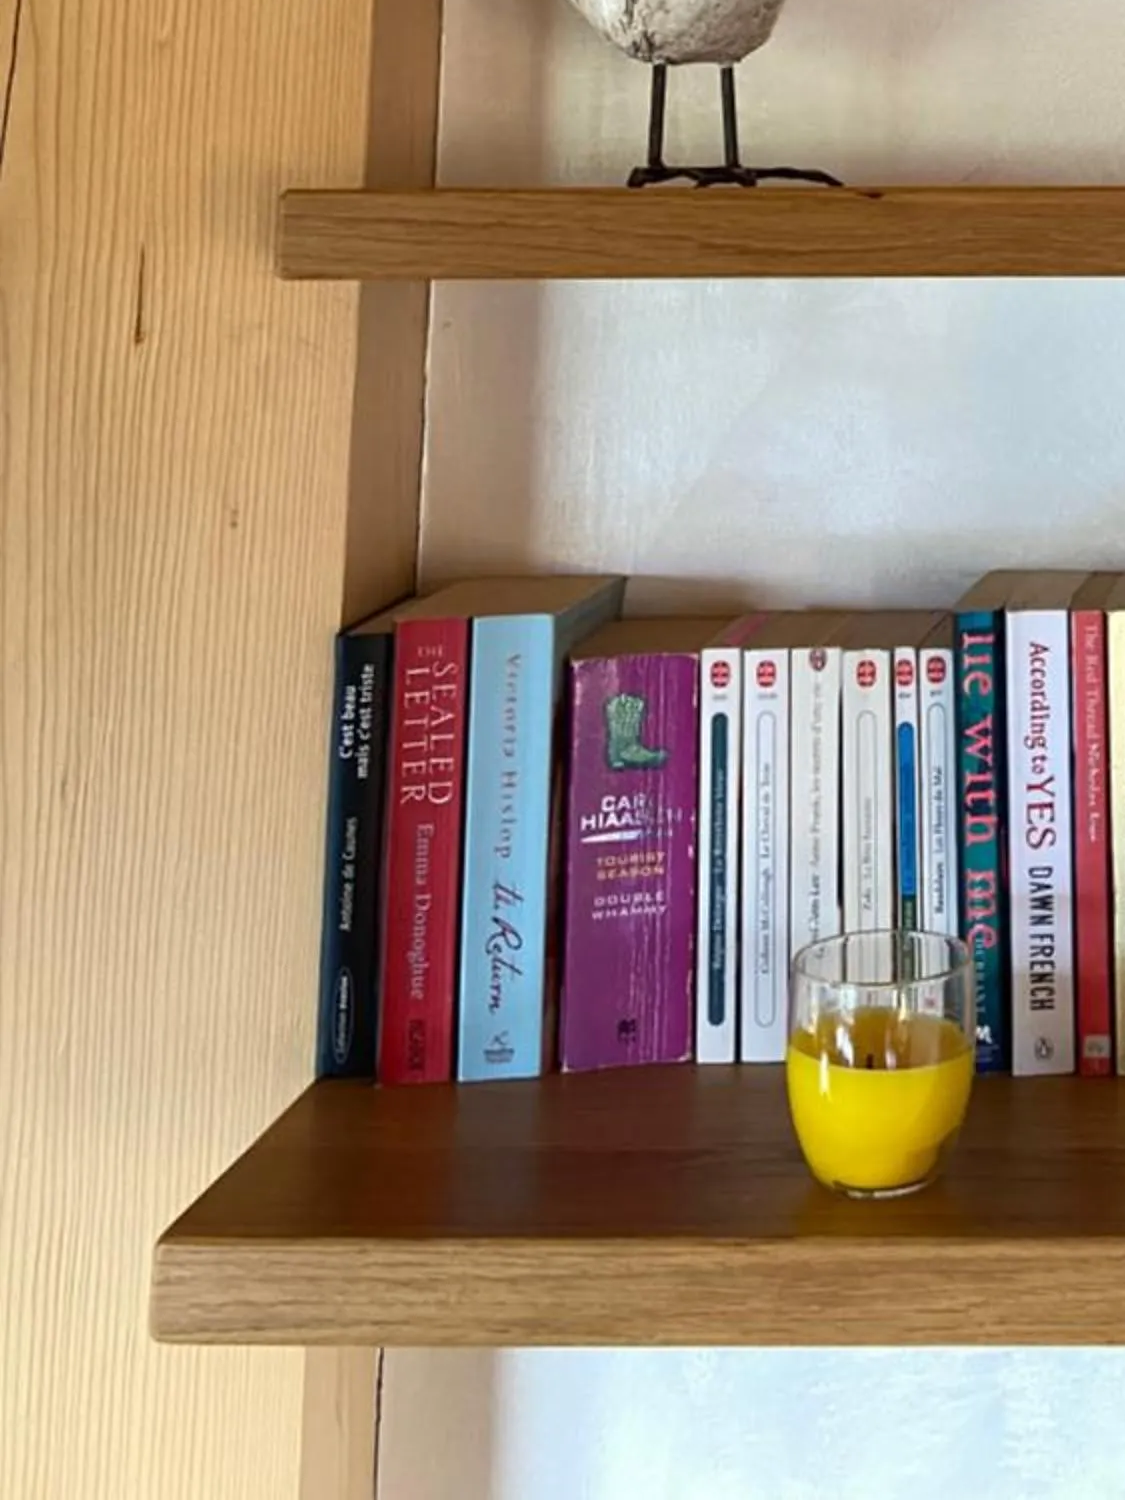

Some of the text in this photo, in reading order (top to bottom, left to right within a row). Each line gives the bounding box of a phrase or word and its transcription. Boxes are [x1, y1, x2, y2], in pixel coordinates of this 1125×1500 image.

[339, 684, 357, 759] C'est beau
[355, 663, 375, 779] mais c'est triste
[400, 667, 430, 805] LETTER
[426, 661, 458, 805] SEALED
[494, 653, 521, 860] Victoria Hislop
[1023, 640, 1058, 851] According to YES
[962, 713, 999, 847] with
[339, 882, 354, 932] Antoine
[341, 864, 354, 879] de
[415, 823, 434, 886] Emma
[594, 891, 664, 907] DOUBLE
[963, 866, 999, 951] me
[408, 893, 433, 1001] Donoghue
[486, 915, 524, 1017] Return
[1028, 865, 1056, 1012] DAWN FRENCH
